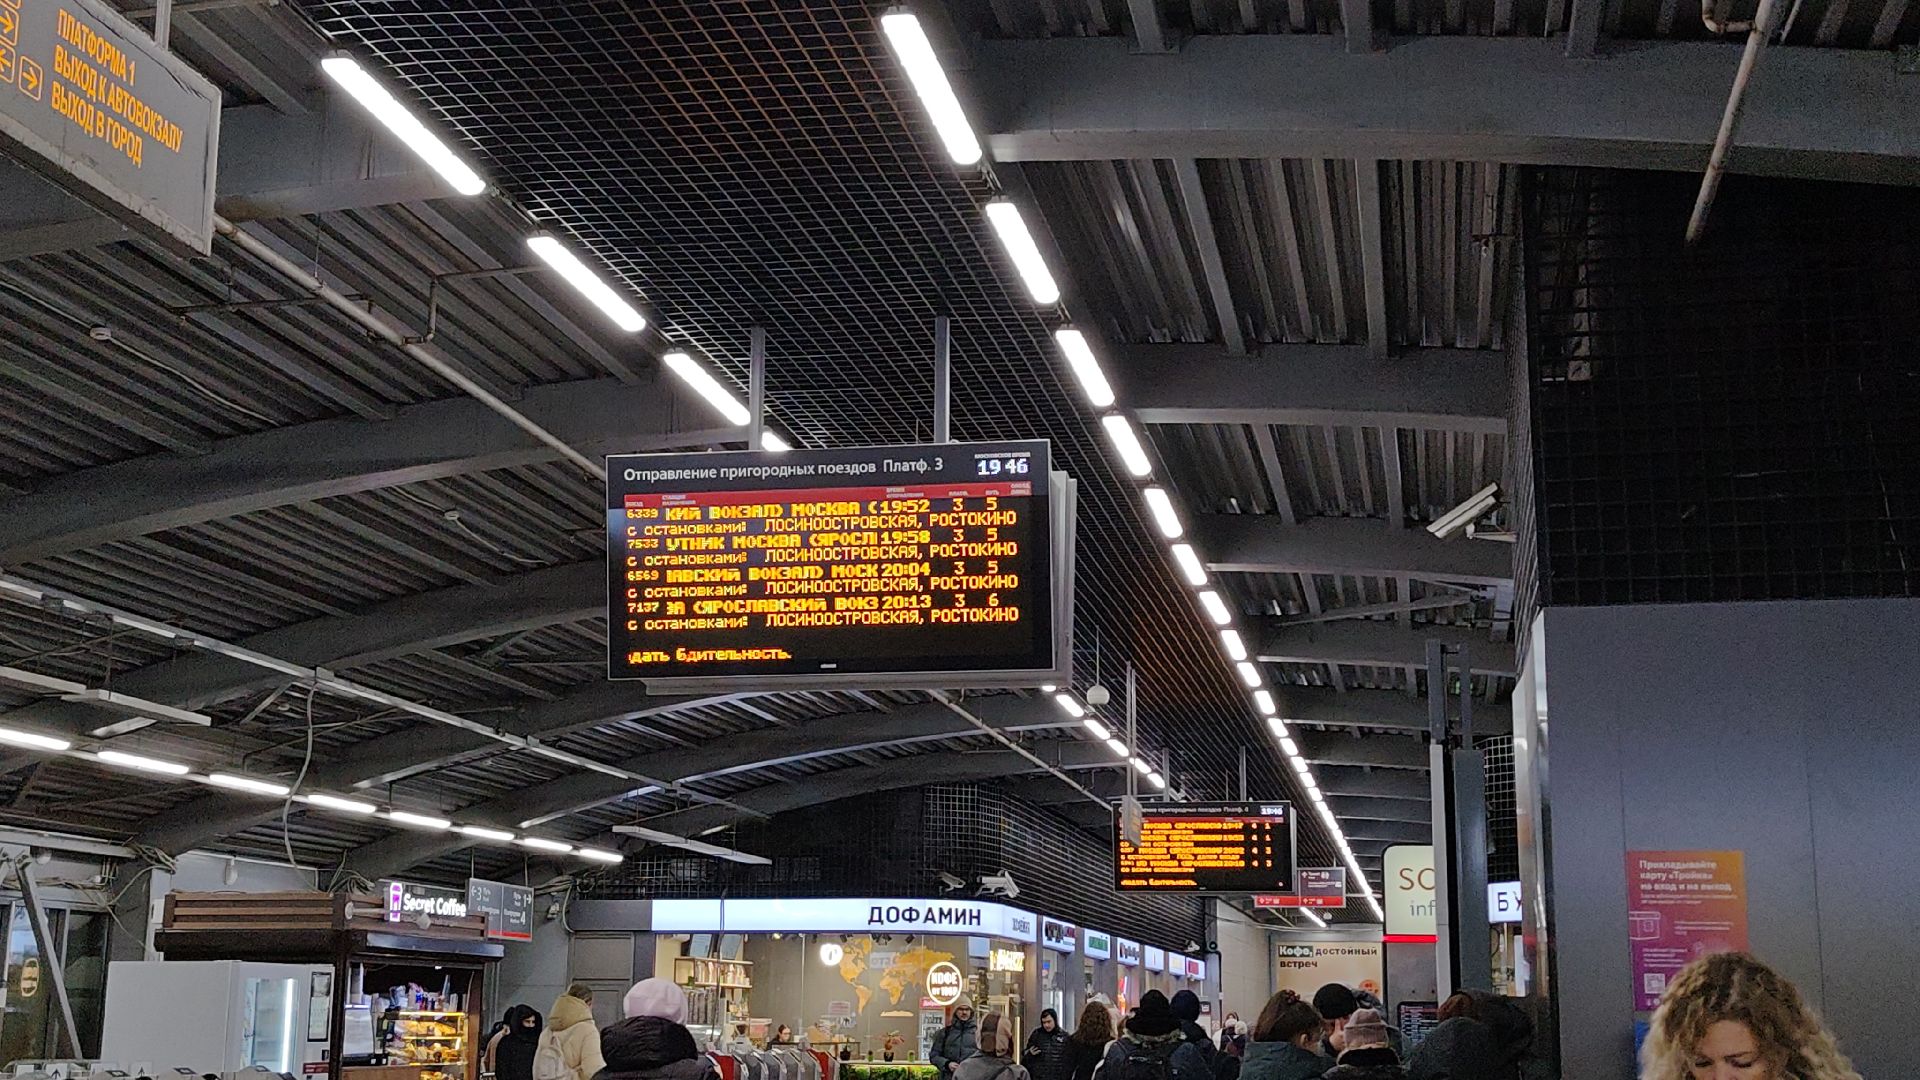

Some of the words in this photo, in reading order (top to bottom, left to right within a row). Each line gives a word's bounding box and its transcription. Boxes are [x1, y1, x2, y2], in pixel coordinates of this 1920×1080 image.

[58, 9, 127, 81] ПЛАТФОРМА
[129, 61, 136, 86] 1
[55, 44, 97, 102] ВЫХОД
[100, 75, 108, 104] К
[107, 83, 183, 153] АВТОВОКЗАЛУ
[52, 81, 95, 138] ВЫХОД
[96, 111, 104, 138] В
[106, 117, 143, 169] ГОРОД
[624, 467, 718, 483] Отправление
[720, 464, 815, 481] пригородных
[818, 461, 876, 476] поездов
[884, 458, 931, 475] Платф.
[934, 456, 944, 471] 3
[978, 459, 1001, 475] 19
[1005, 458, 1028, 474] 46
[627, 508, 659, 519] 6339
[709, 503, 783, 519] ВОКЗАЛ)
[792, 501, 860, 517] МОСКВА
[880, 499, 930, 515] 19:52
[953, 498, 964, 511] 3
[986, 497, 998, 511] 5
[644, 522, 747, 536] остановками:
[765, 514, 923, 533] ЛОСИНООСТРОВСКАЯ,
[929, 510, 1017, 527] РОСТОКИНО
[627, 538, 659, 549] 7533
[666, 536, 725, 551] УТНИК
[732, 533, 801, 550] МОСКВА
[880, 530, 931, 546] 19:58
[953, 529, 964, 542] 3
[987, 528, 998, 542] 5
[644, 551, 748, 566] остановками:
[765, 545, 923, 564] ЛОСИНООСТРОВСКАЯ,
[929, 541, 1018, 558] РОСТОКИНО
[627, 570, 659, 581] 6569
[748, 565, 824, 581] ВОКЗАЛ)
[831, 563, 879, 579] МОСК
[881, 562, 931, 577] 20:04
[953, 561, 965, 575] 3
[987, 560, 998, 574] 5
[644, 583, 748, 598] остановками:
[765, 576, 924, 595] ЛОСИНООСТРОВСКАЯ,
[930, 574, 1018, 591] РОСТОКИНО
[628, 602, 660, 613] 7137
[835, 595, 879, 611] ВОКЗ
[882, 595, 932, 610] 20:13
[954, 593, 965, 607] 3
[988, 592, 999, 606] 6
[644, 615, 749, 631] остановками:
[766, 608, 925, 628] ЛОСИНООСТРОВСКАЯ,
[930, 607, 1019, 624] РОСТОКИНО
[676, 647, 793, 664] бдительность.
[1640, 872, 1668, 881] карту
[403, 893, 435, 914] Secret
[436, 897, 466, 917] Coffee
[868, 906, 981, 926] ДОФАМИН
[1279, 946, 1313, 957] Кофе,
[1315, 946, 1378, 956] достойный
[1279, 961, 1318, 970] встреч
[931, 971, 959, 985] КОФЕ
